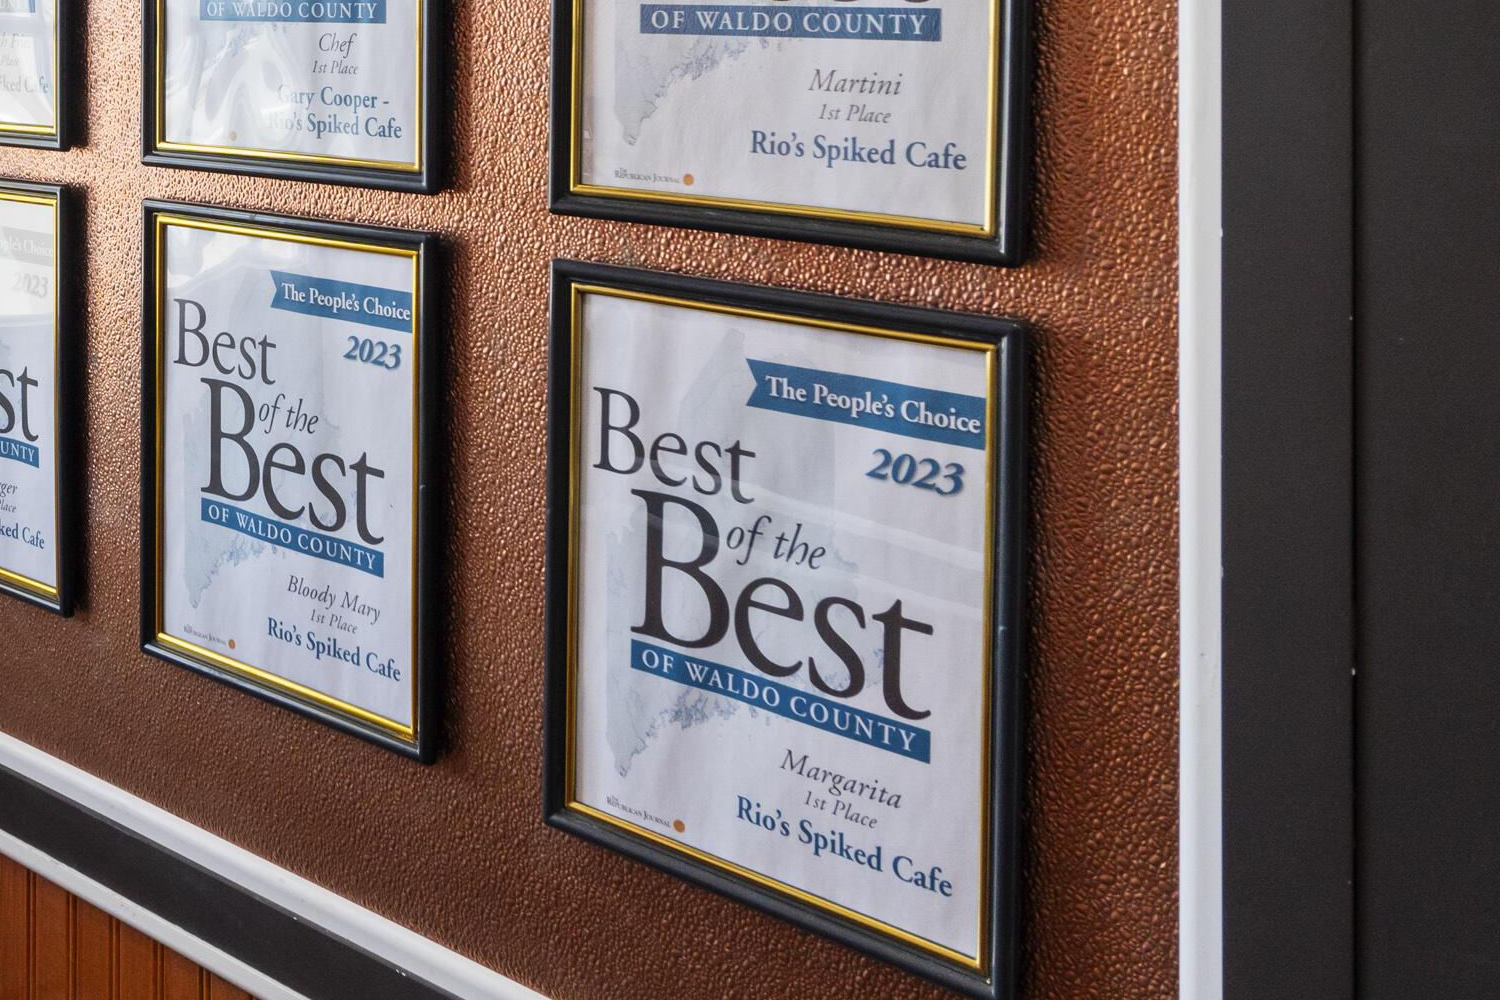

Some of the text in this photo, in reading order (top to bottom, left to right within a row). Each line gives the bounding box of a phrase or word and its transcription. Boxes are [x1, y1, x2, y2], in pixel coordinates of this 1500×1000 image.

[207, 2, 377, 19] OF WALDO COUNTY
[651, 9, 927, 35] OF WALDO COUNTY
[318, 33, 357, 58] Chef
[312, 60, 358, 76] 1st Place
[808, 68, 903, 96] Martini
[278, 84, 315, 109] Gary
[320, 86, 378, 115] Cooper
[818, 103, 892, 125] 1st Place
[306, 113, 359, 139] Spiked
[365, 116, 402, 139] Cafe
[750, 130, 967, 170] Rio's Spiked Cafe
[12, 271, 49, 298] 2023
[281, 282, 411, 321] The People's Choice
[173, 298, 277, 385] Best
[343, 335, 402, 370] 2023
[259, 393, 319, 434] of the
[765, 375, 981, 434] The People's Choice
[200, 377, 385, 545] Best
[592, 385, 756, 505] Best
[865, 448, 966, 496] 2023
[22, 527, 45, 549] Cafe
[208, 504, 376, 571] OF WALDO COUNTY
[726, 515, 827, 570] of the
[287, 575, 381, 626] Bloody Mary
[630, 488, 935, 720] Best
[310, 609, 358, 634] 1st Place
[267, 617, 401, 682] Rio's Spiked Cafe
[641, 649, 917, 754] OF WALDO COUNTY
[779, 748, 903, 809] Margarita
[805, 790, 879, 830] 1st Place
[736, 795, 953, 897] Rio's Spiked Cafe
